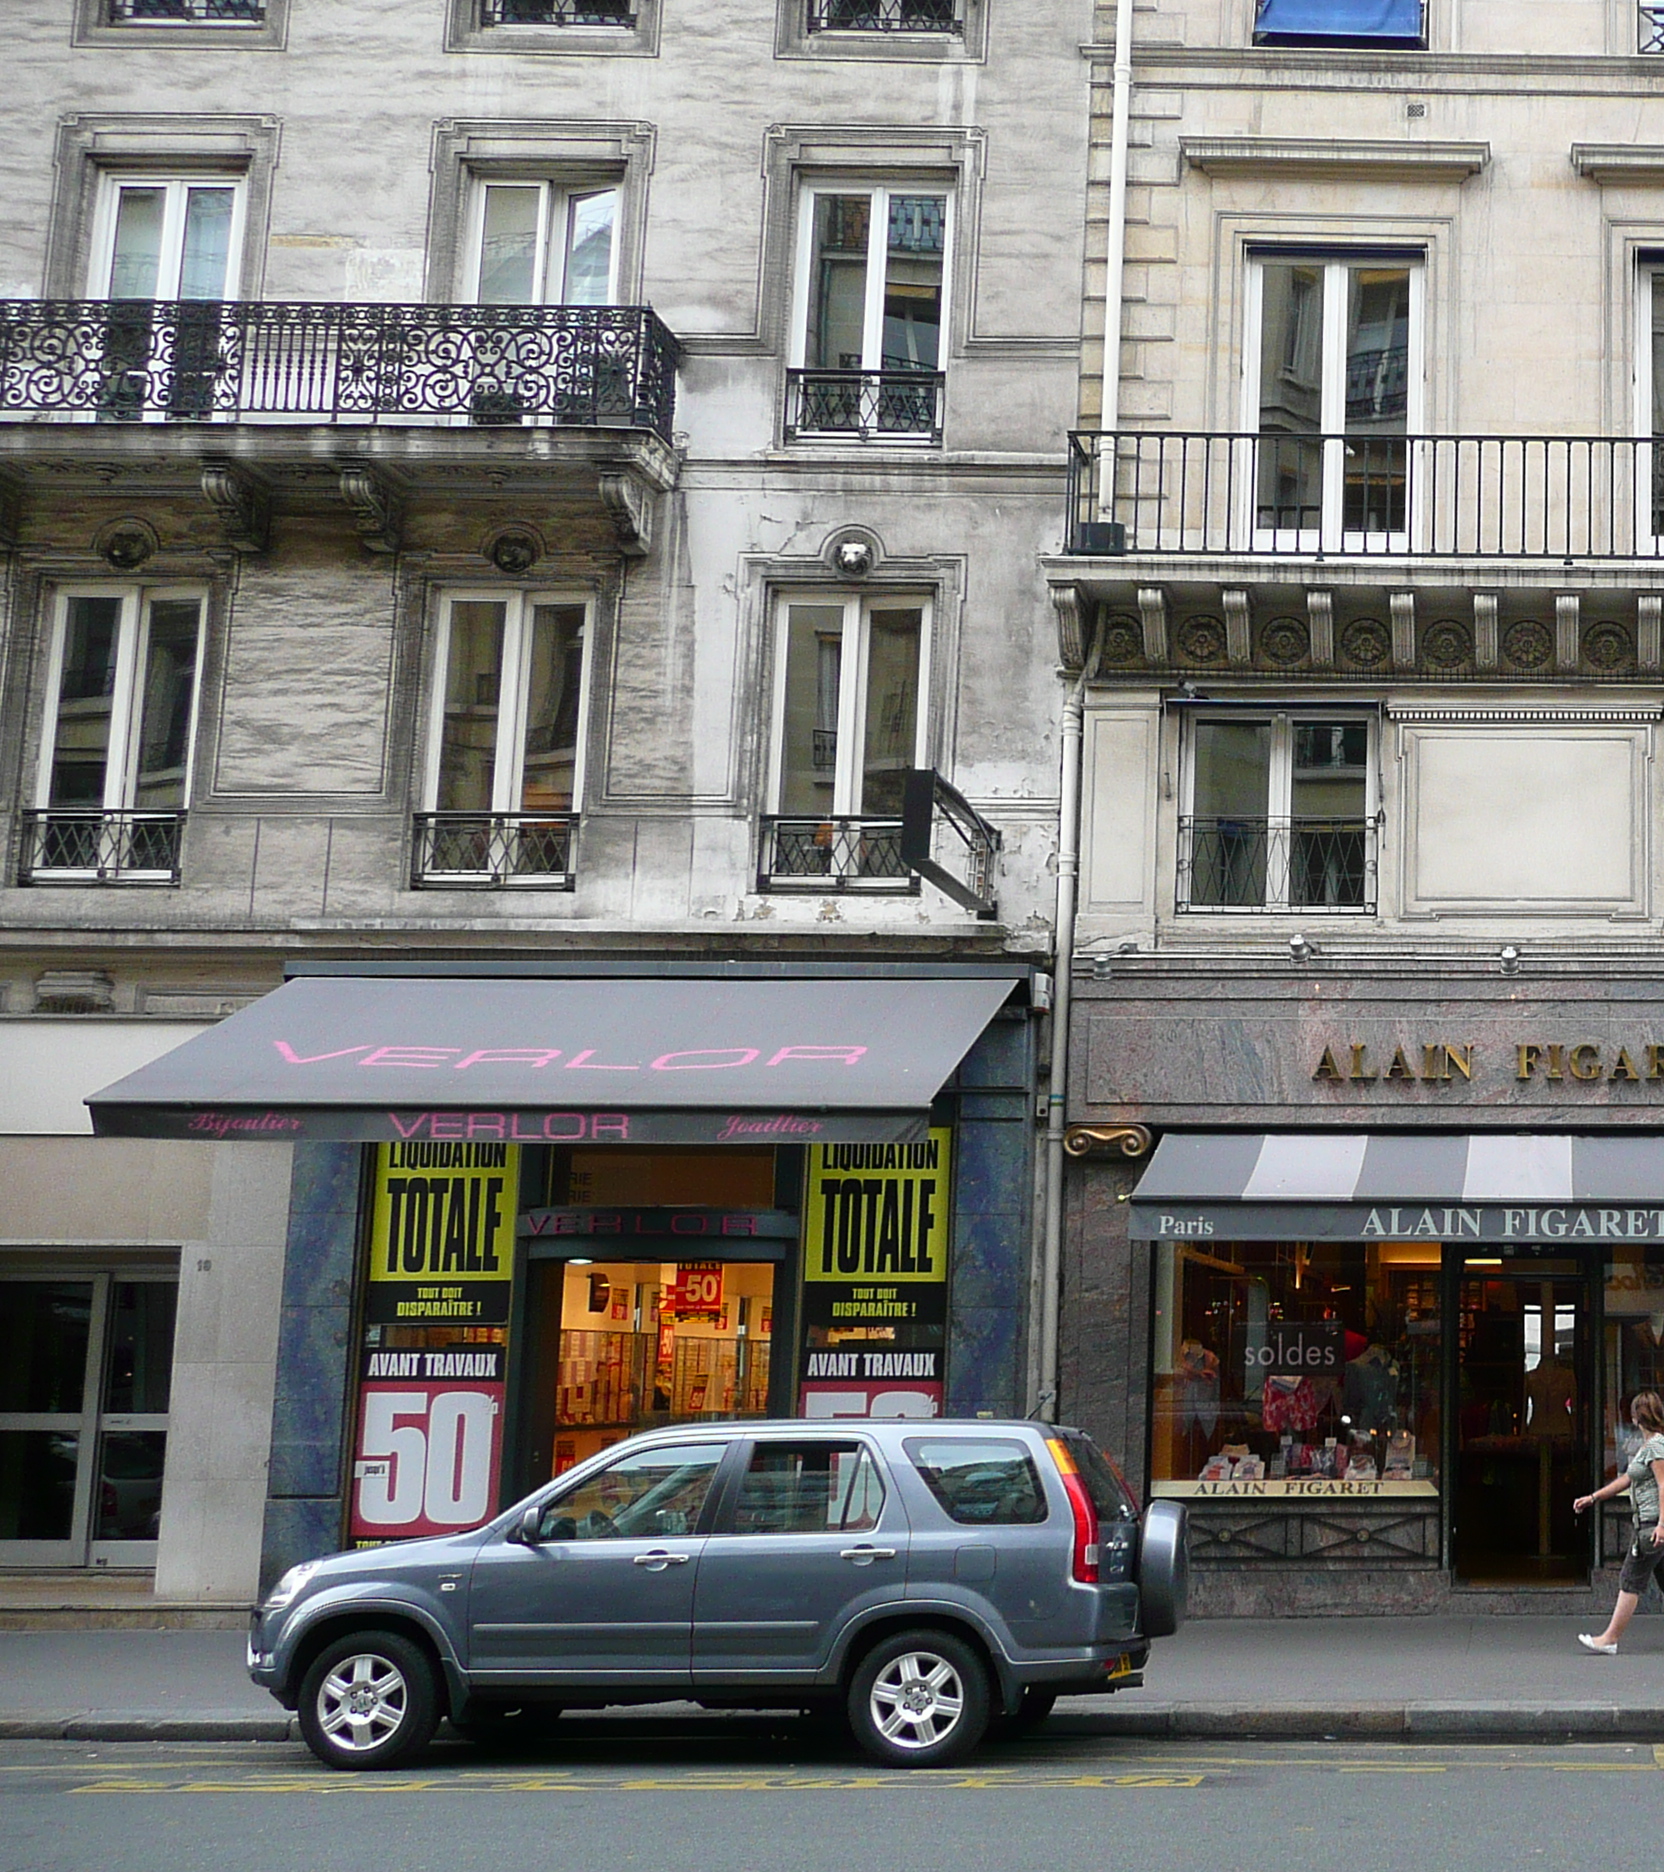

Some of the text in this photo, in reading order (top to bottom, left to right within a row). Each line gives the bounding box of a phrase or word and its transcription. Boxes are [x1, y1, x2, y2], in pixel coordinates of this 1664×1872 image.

[273, 1040, 868, 1071] VERLOR
[1311, 1043, 1475, 1081] ALAIN
[388, 1112, 630, 1139] VERLOR
[717, 1114, 823, 1140] Joaillier
[389, 1142, 507, 1170] LIQUIDATION
[822, 1138, 938, 1171] LIQUIDATION
[387, 1177, 504, 1273] TOTALE
[527, 1214, 758, 1235] VERLOR
[821, 1178, 935, 1274] TOTALE
[1159, 1216, 1214, 1235] Paris
[1361, 1208, 1483, 1237] ALAIN
[417, 1288, 463, 1298] TOUT DOIT
[852, 1288, 897, 1299] TOUT DOIT
[397, 1300, 473, 1317] DISPARAÎTRE
[832, 1301, 908, 1317] DISPARAÎTRE
[1245, 1332, 1335, 1365] soldes
[368, 1353, 497, 1377] AVANT TRAVAUX
[807, 1353, 935, 1377] AVANT TRAVAUX
[1194, 1482, 1384, 1495] ALAIN FIGARET
